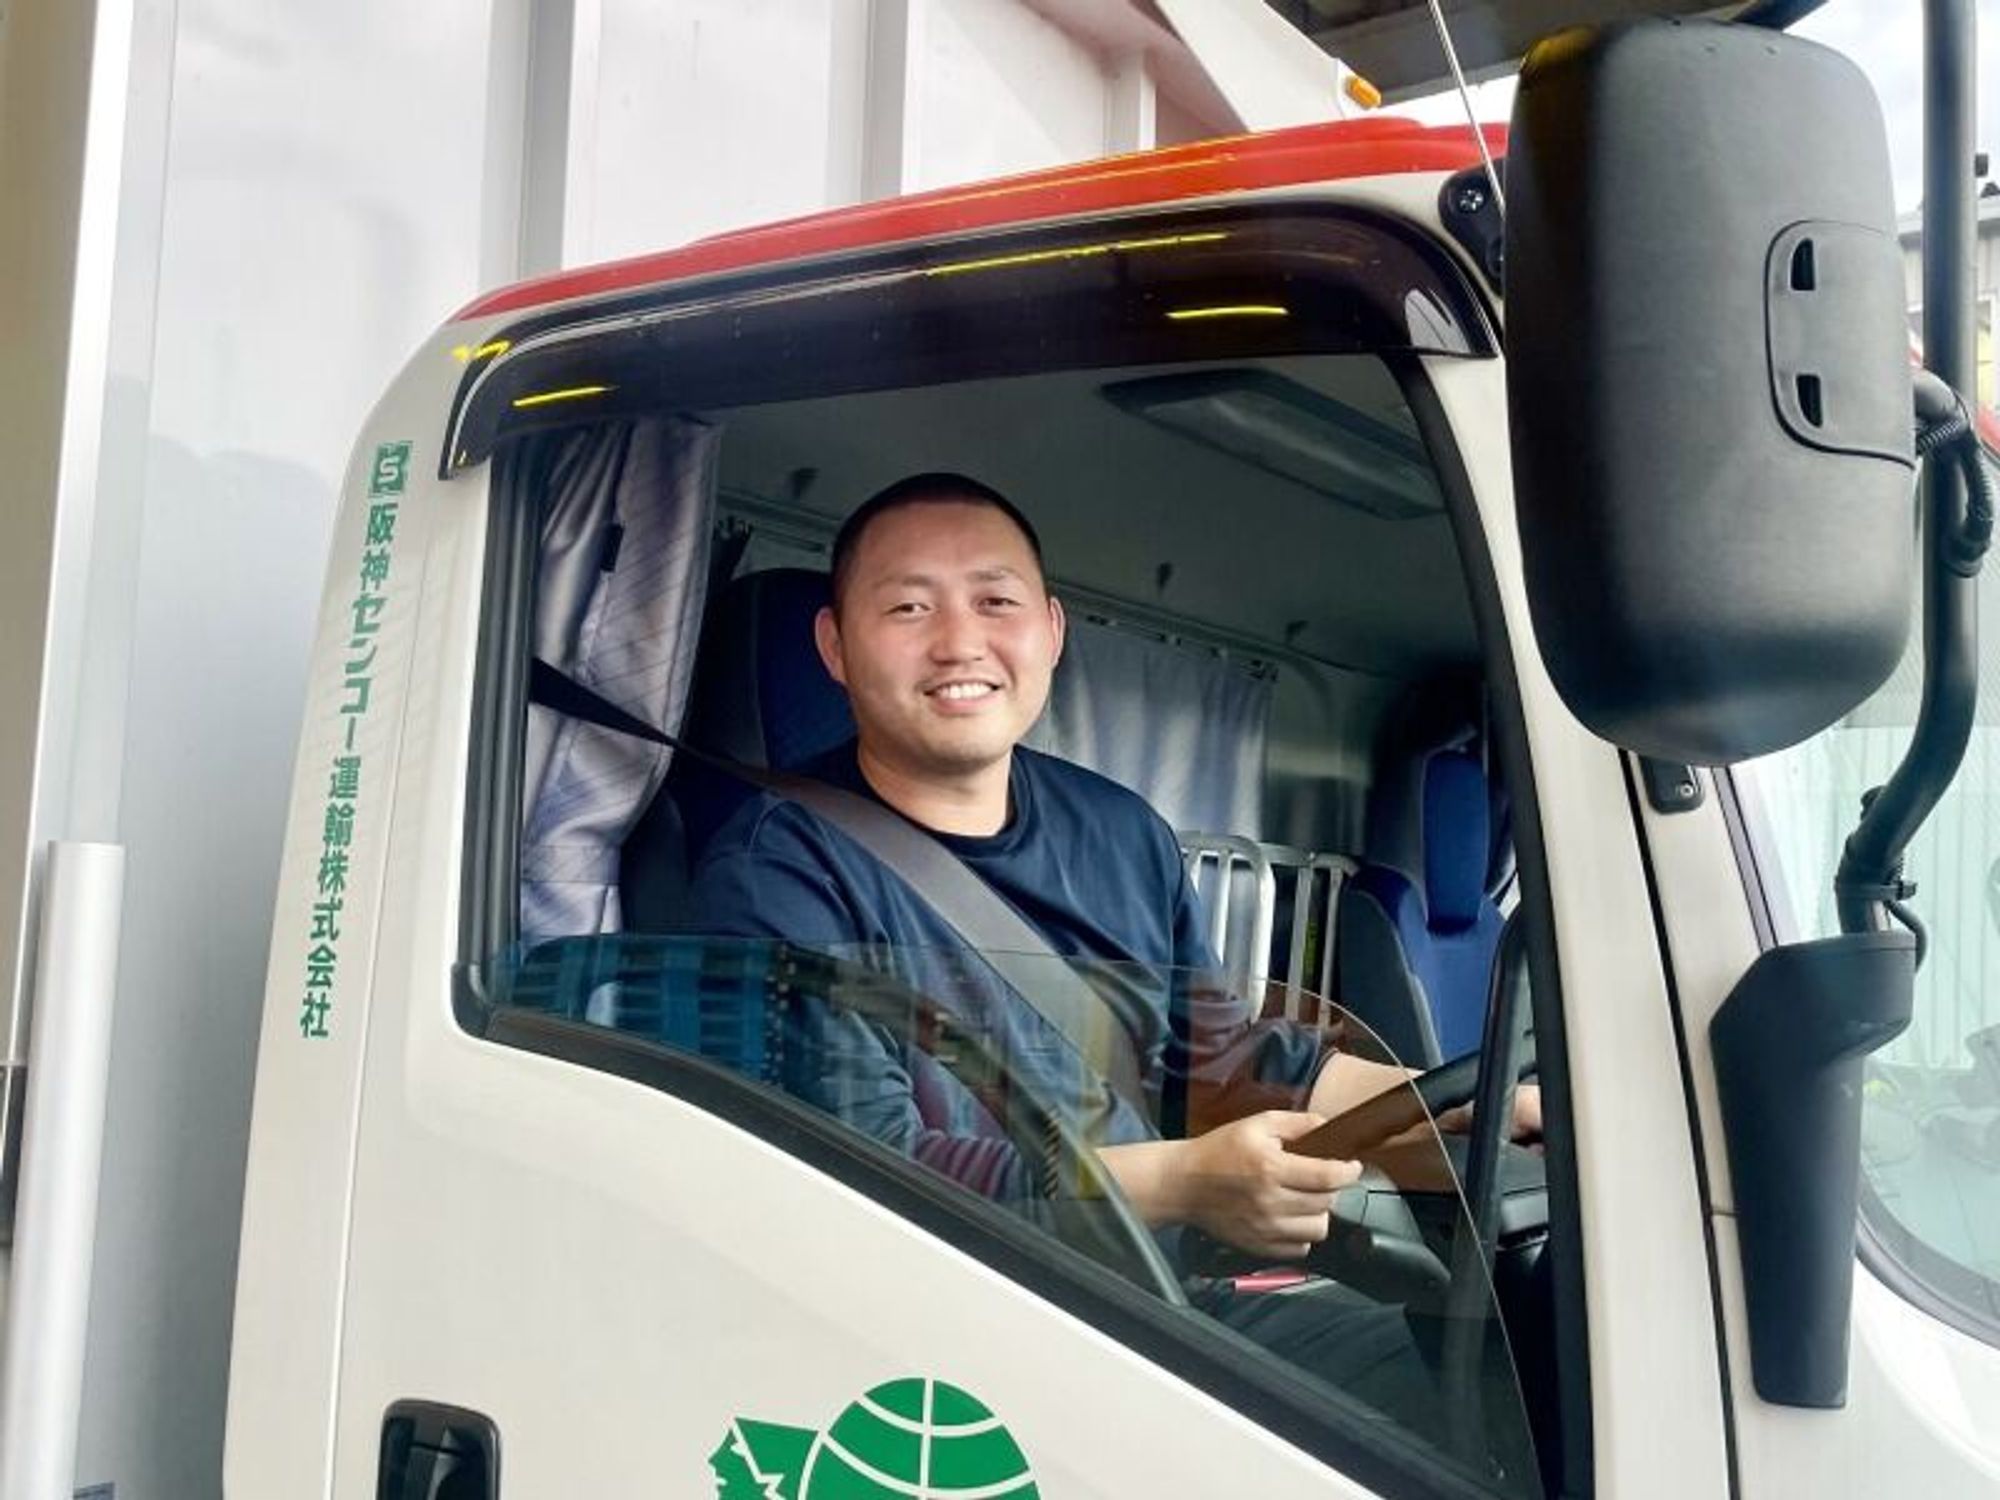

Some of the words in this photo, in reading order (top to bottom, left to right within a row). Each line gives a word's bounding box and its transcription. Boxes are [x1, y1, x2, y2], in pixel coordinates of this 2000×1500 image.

[300, 502, 399, 1038] 阪神センコー運輸株式会社
